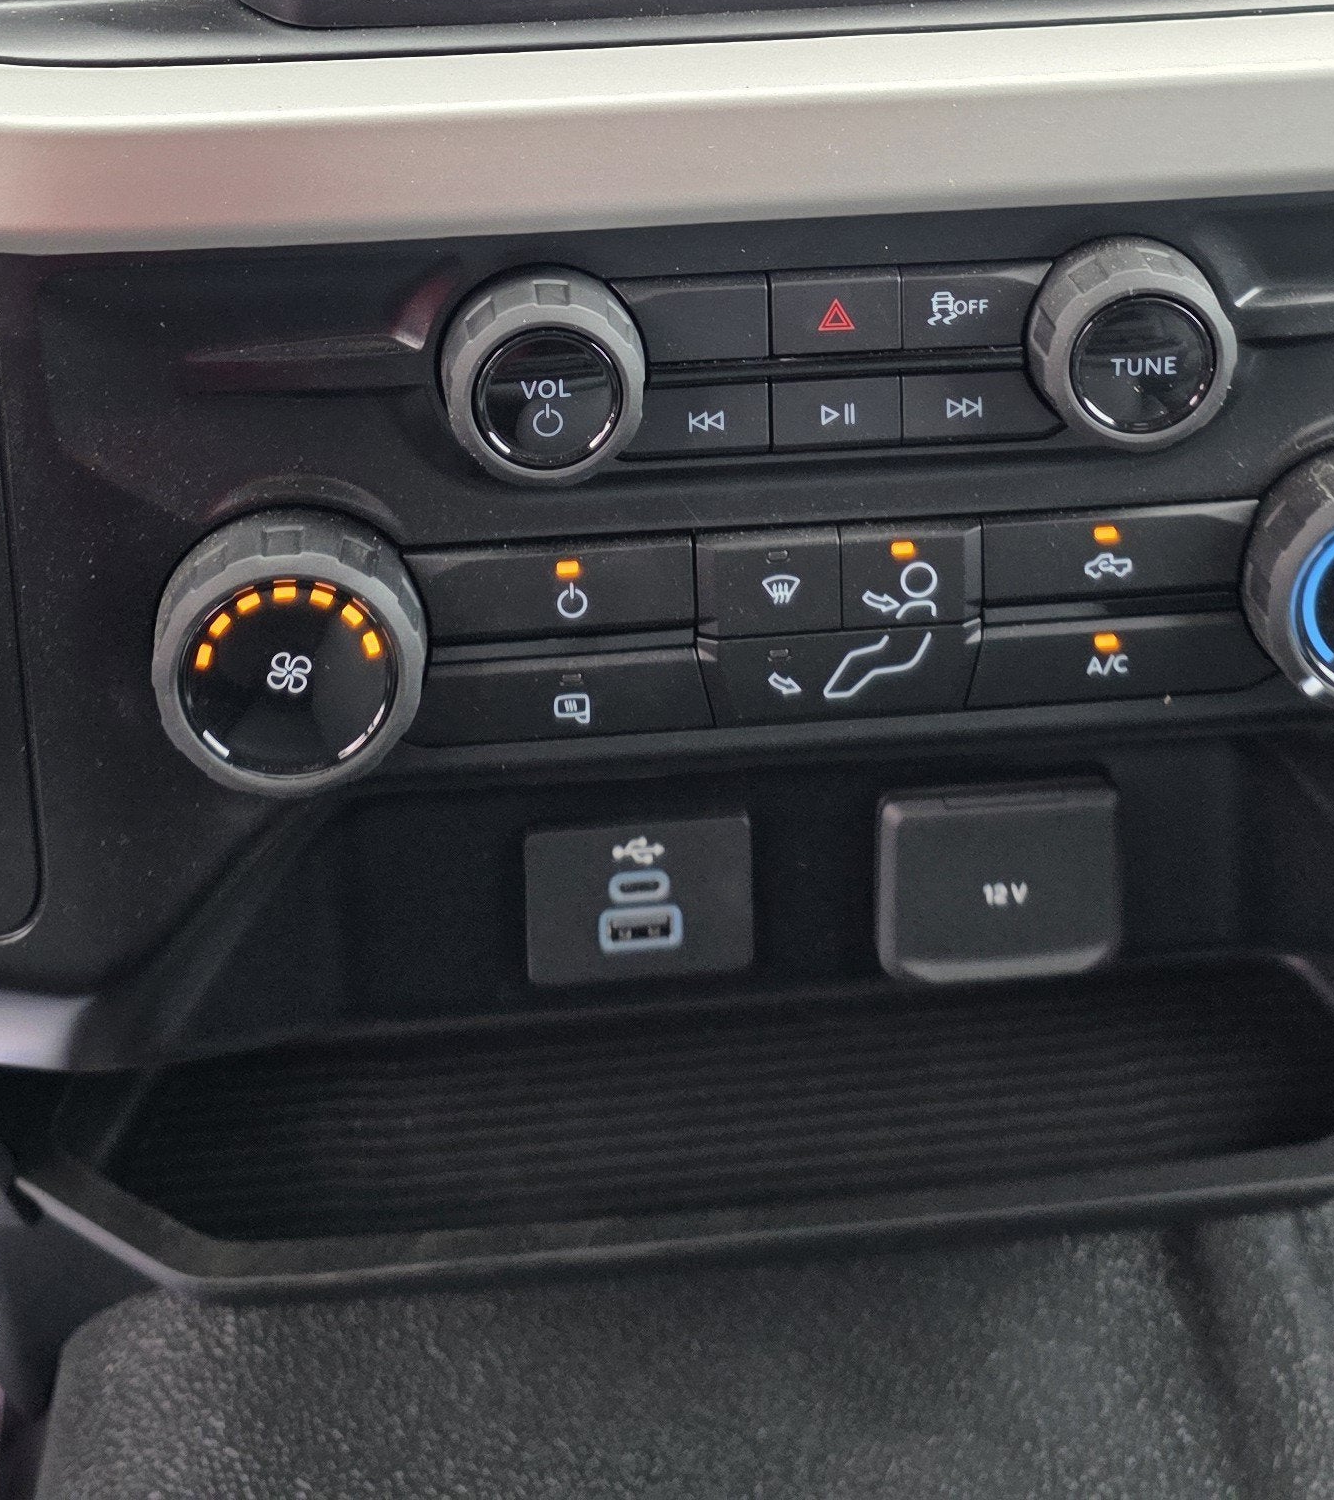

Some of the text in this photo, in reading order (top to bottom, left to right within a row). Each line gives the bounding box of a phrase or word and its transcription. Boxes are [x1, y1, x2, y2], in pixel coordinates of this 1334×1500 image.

[953, 298, 990, 316] OFF
[1110, 355, 1178, 377] TUNE
[520, 378, 572, 400] VOL
[1086, 653, 1130, 677] A/C
